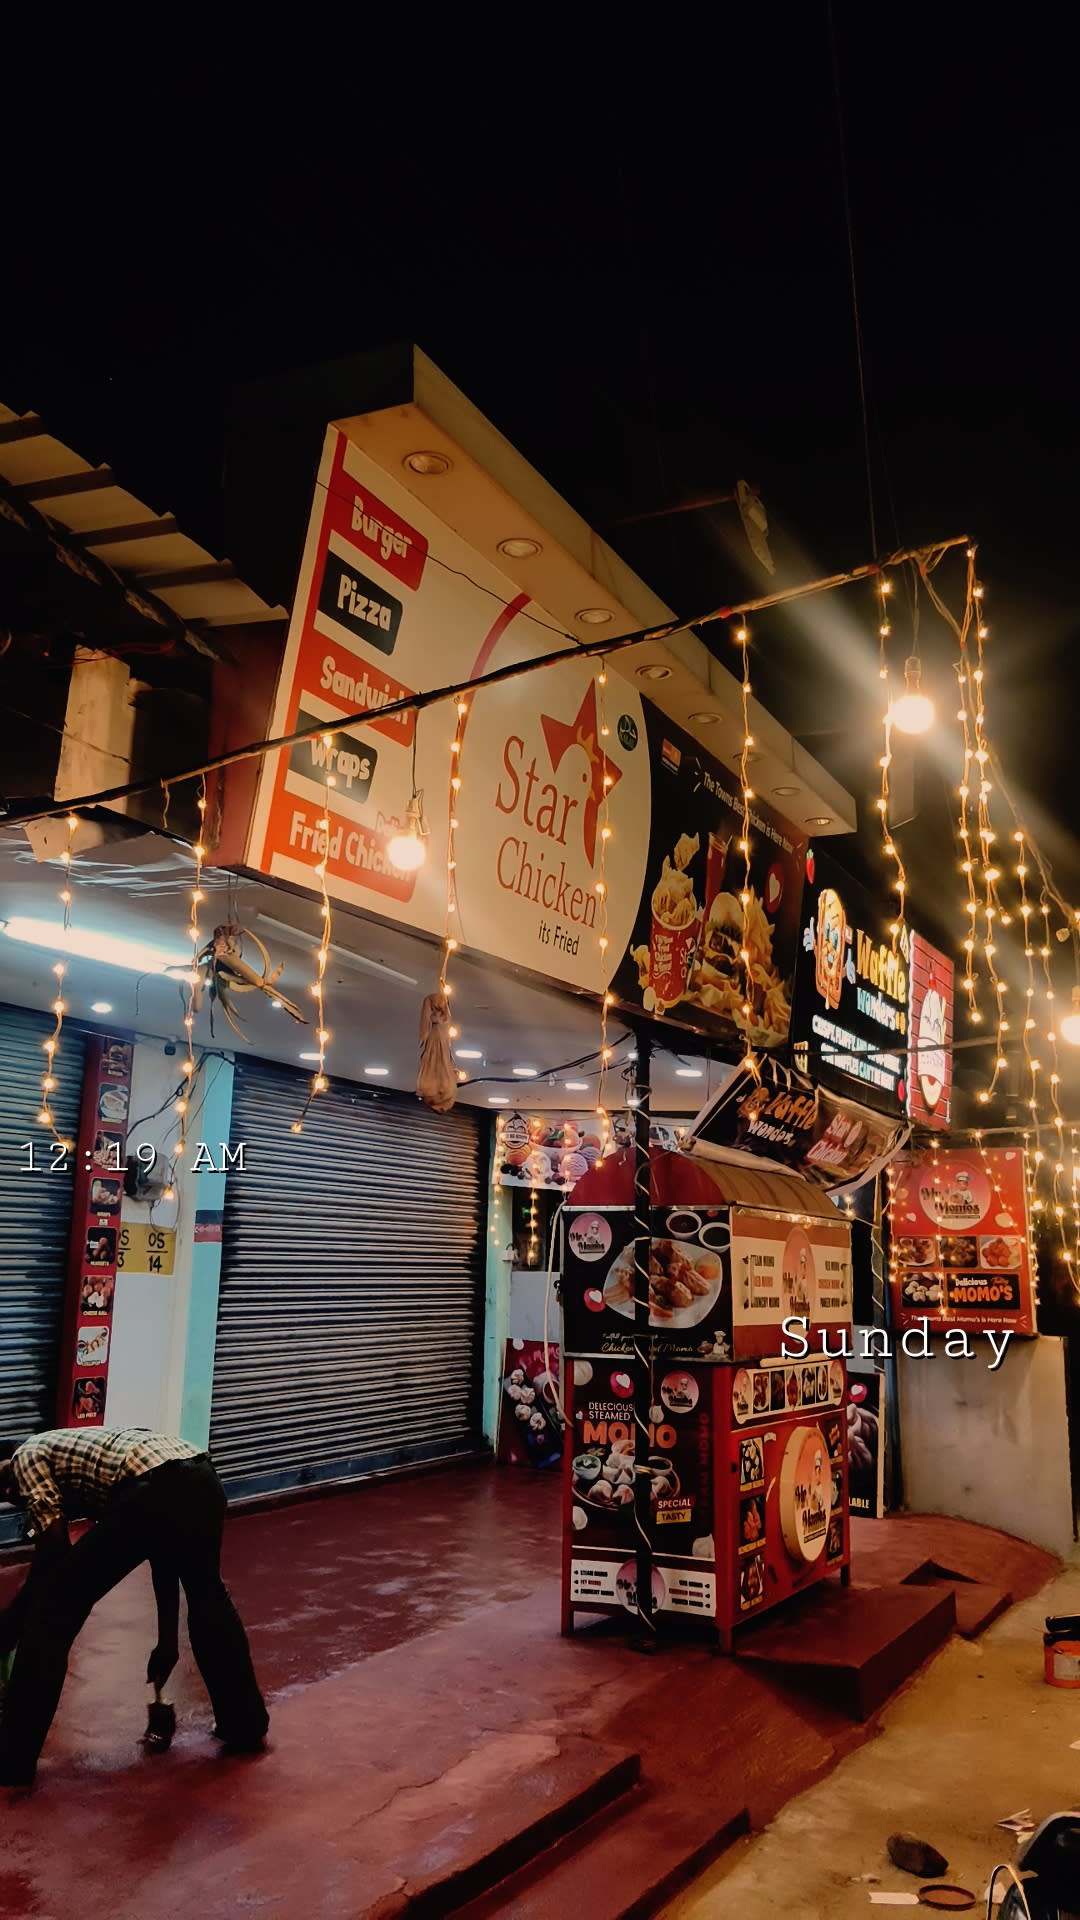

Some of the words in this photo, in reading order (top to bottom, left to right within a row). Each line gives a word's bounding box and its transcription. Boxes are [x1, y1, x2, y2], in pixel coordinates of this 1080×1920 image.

[352, 495, 412, 561] Burger
[337, 573, 392, 632] Pizza
[311, 738, 370, 788] Wraps
[495, 735, 578, 846] Star
[289, 810, 343, 860] Fried
[497, 836, 596, 929] Chicken
[538, 920, 551, 945] its
[553, 924, 580, 956] Fried
[149, 1255, 162, 1273] 14
[953, 1285, 1013, 1303] MOMO'S
[955, 1277, 988, 1287] Delicious
[588, 1401, 634, 1412] DELECIOUS
[588, 1410, 631, 1421] STEAMED
[656, 1499, 692, 1510] SPECIAL
[662, 1512, 687, 1521] TASTY
